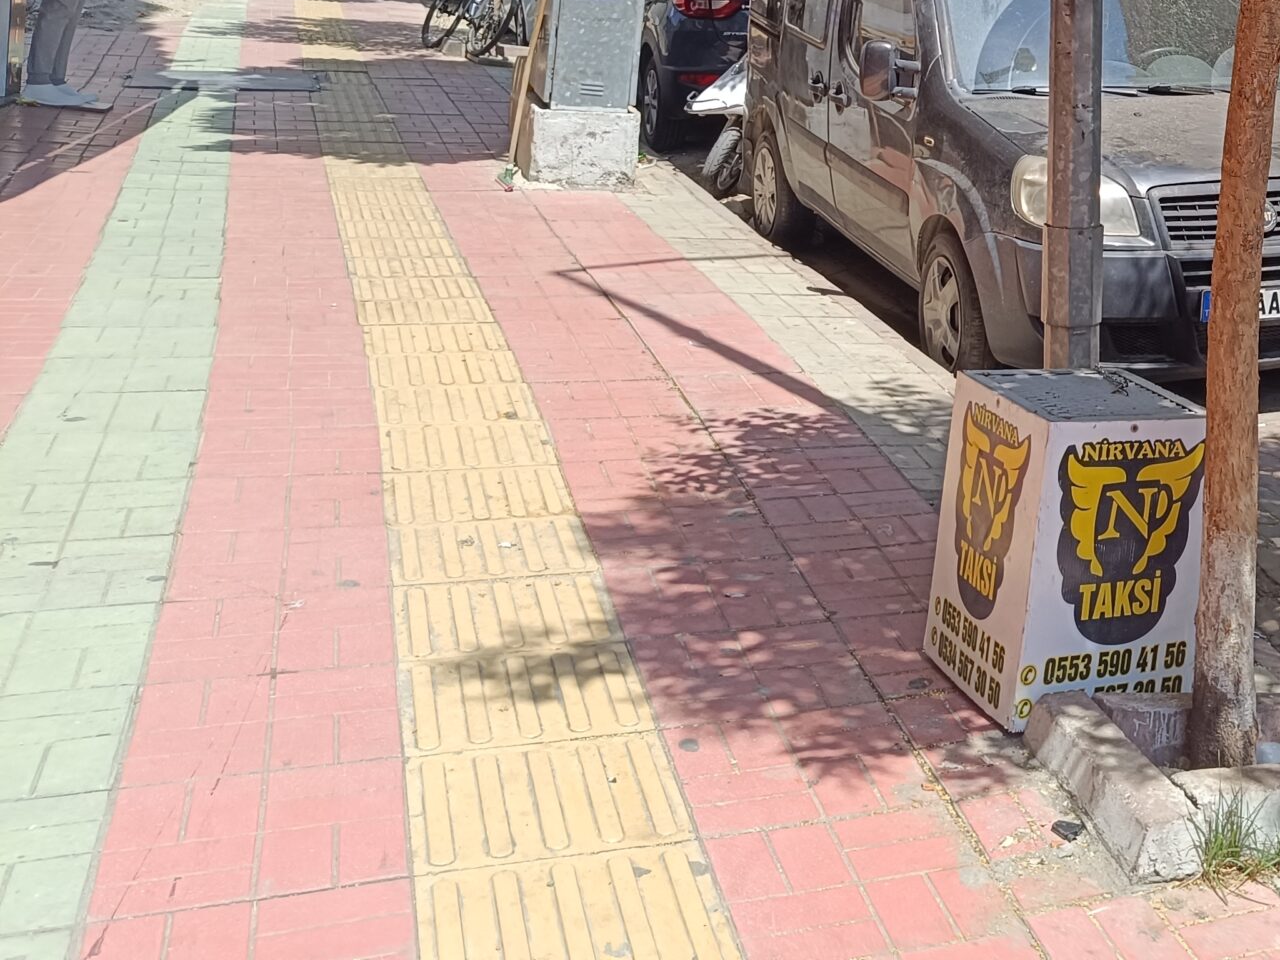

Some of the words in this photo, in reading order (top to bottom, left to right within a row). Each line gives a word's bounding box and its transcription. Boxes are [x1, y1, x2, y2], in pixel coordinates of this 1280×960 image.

[1083, 438, 1186, 463] NİRVANA
[961, 540, 997, 601] TAKSİ
[1080, 570, 1162, 620] TAKSİ
[942, 598, 961, 637] 0553
[962, 614, 978, 652] 590
[979, 631, 991, 663] 41
[992, 641, 1006, 674] 56
[1043, 653, 1092, 685] 0553
[1096, 648, 1132, 678] 590
[1136, 644, 1159, 672] 41
[1164, 641, 1187, 669] 56
[938, 631, 957, 672] 0534
[958, 649, 975, 687] 567
[975, 665, 987, 698] 30
[988, 676, 1001, 710] 50
